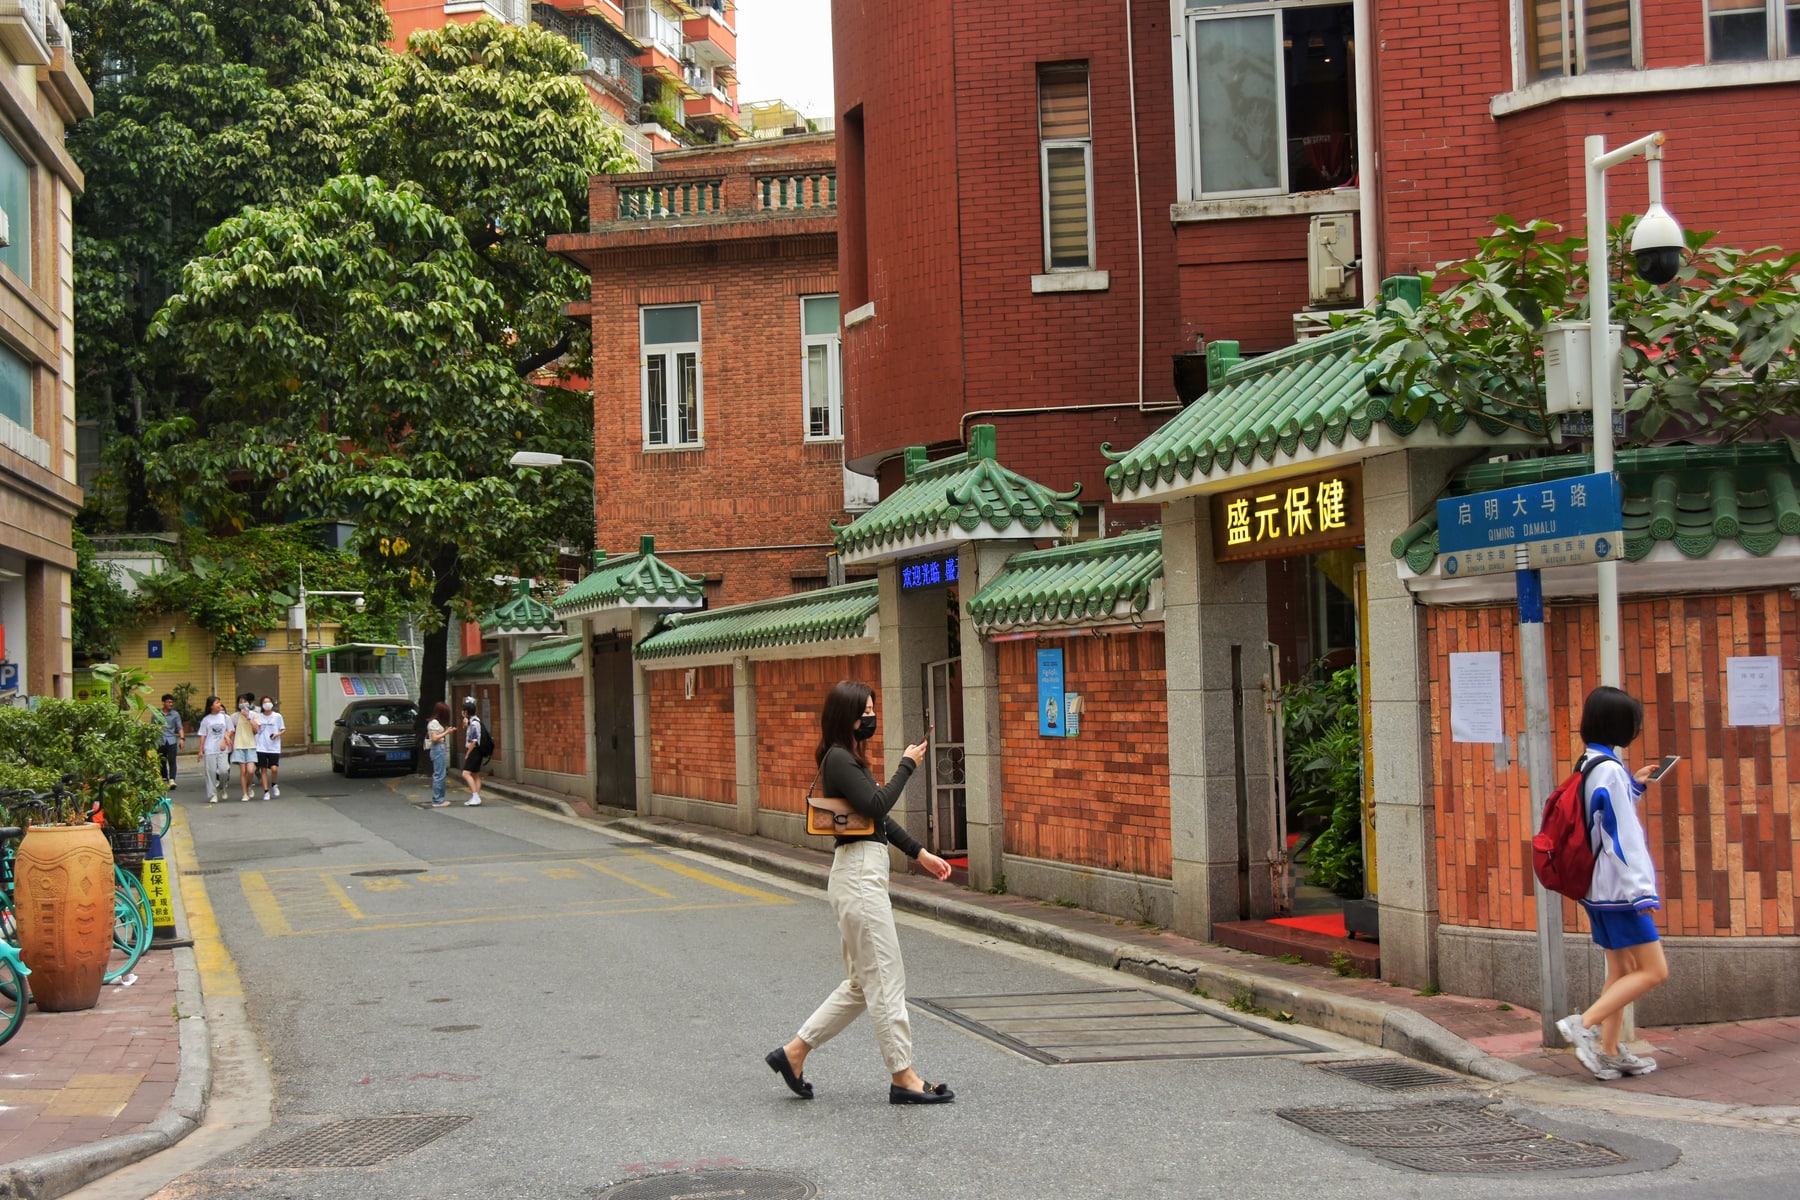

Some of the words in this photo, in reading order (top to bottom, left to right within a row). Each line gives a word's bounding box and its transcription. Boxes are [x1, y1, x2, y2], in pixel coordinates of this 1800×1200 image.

[1227, 478, 1346, 545] 盛元保健
[1458, 483, 1587, 525] 启明大马路
[1488, 526, 1515, 541] QIMING
[1523, 520, 1556, 537] DAMALU
[1597, 541, 1607, 554] 北
[1, 665, 16, 686] P
[150, 863, 164, 897] 医保卡
